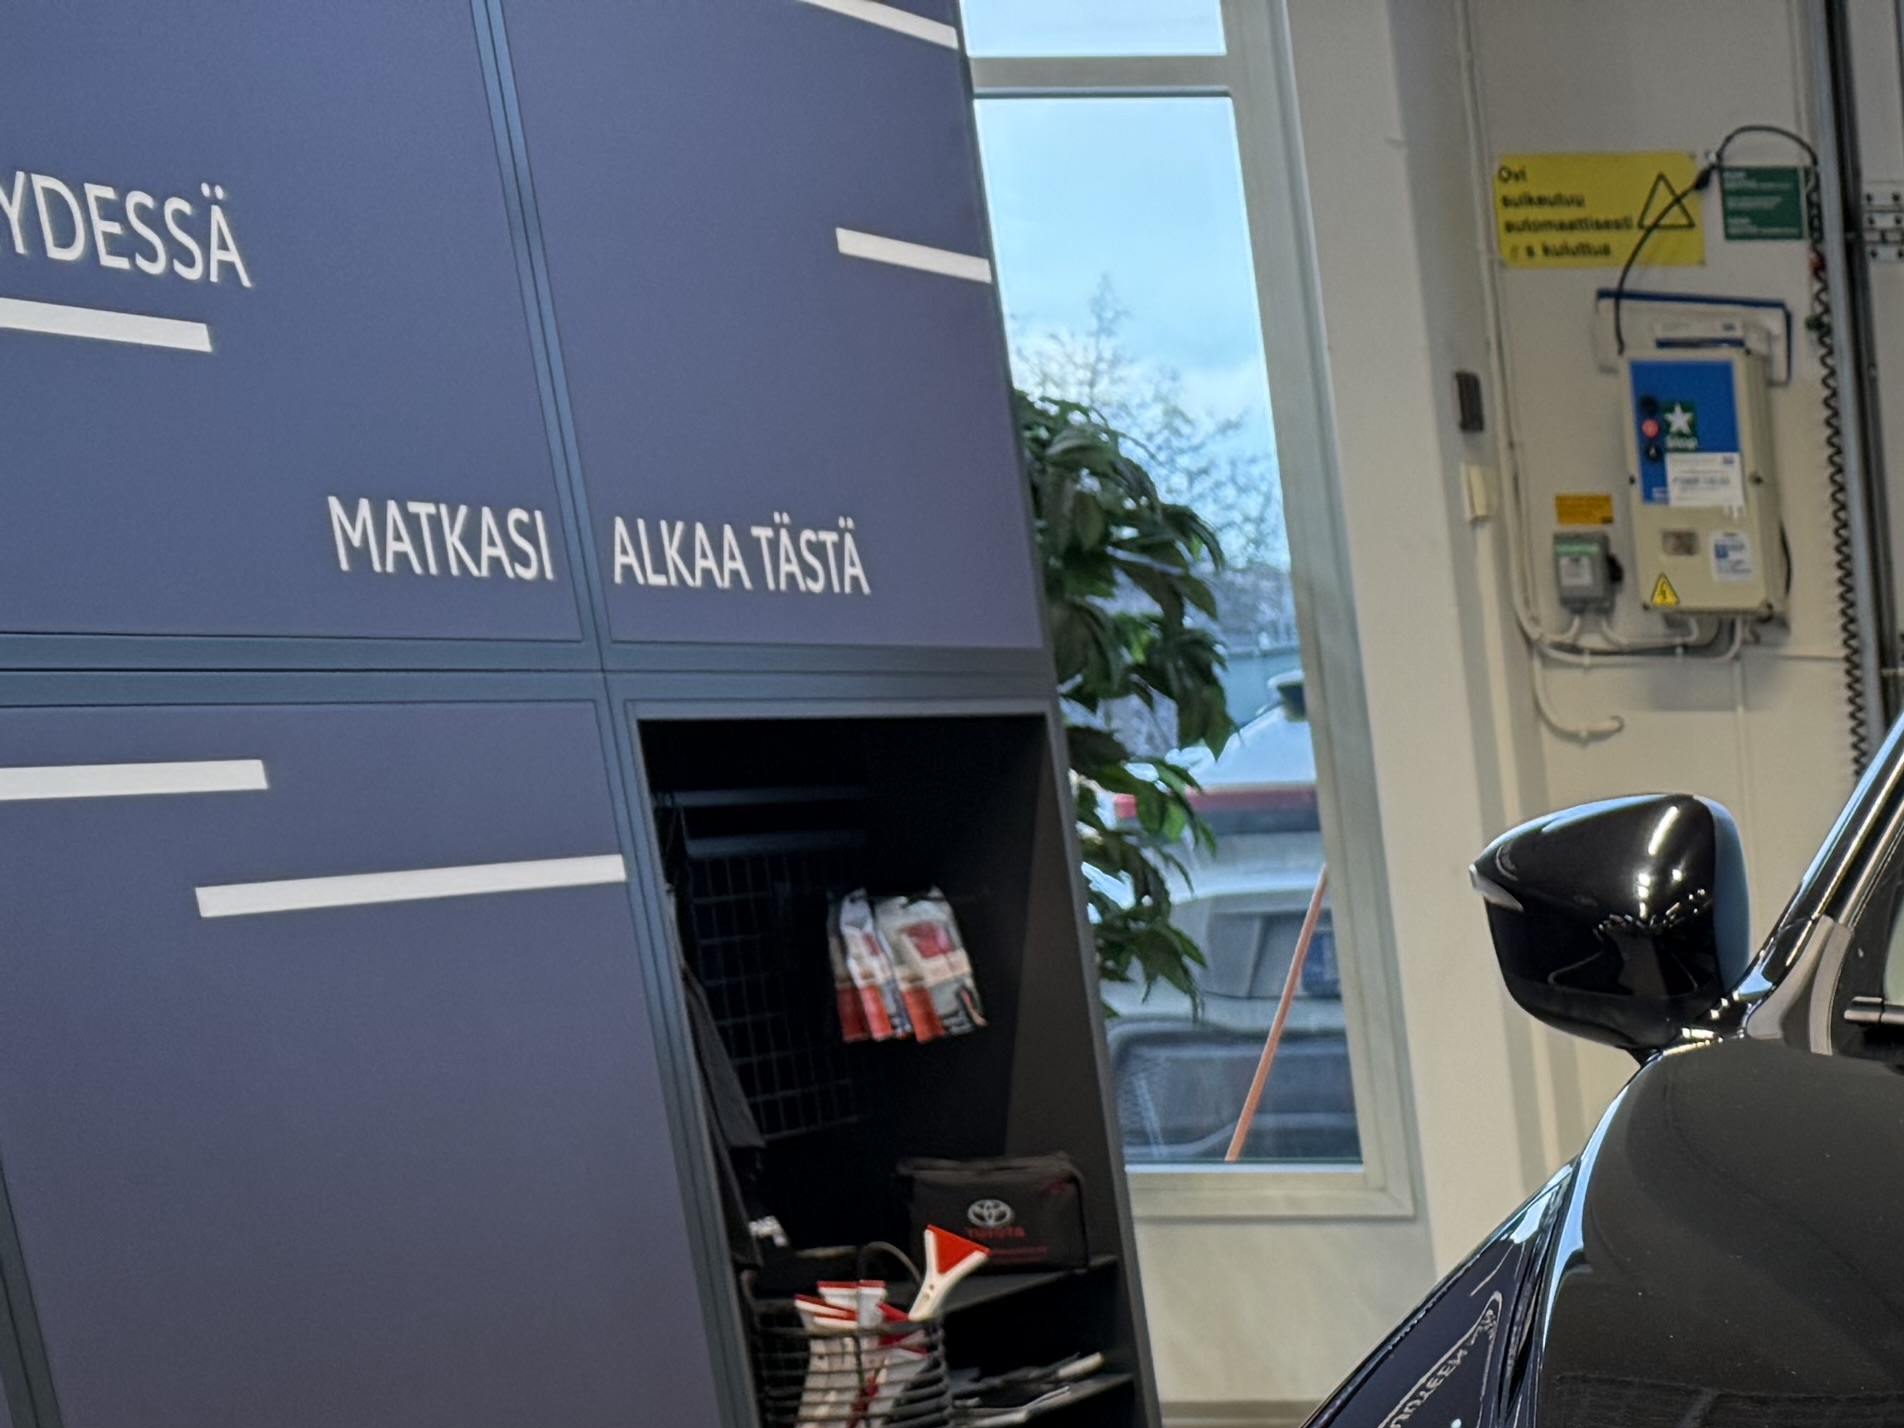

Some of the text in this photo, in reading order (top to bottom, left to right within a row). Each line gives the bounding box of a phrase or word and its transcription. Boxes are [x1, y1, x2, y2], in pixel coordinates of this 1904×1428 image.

[327, 496, 872, 595] MATKASI ALKAA TÄSTÄ
